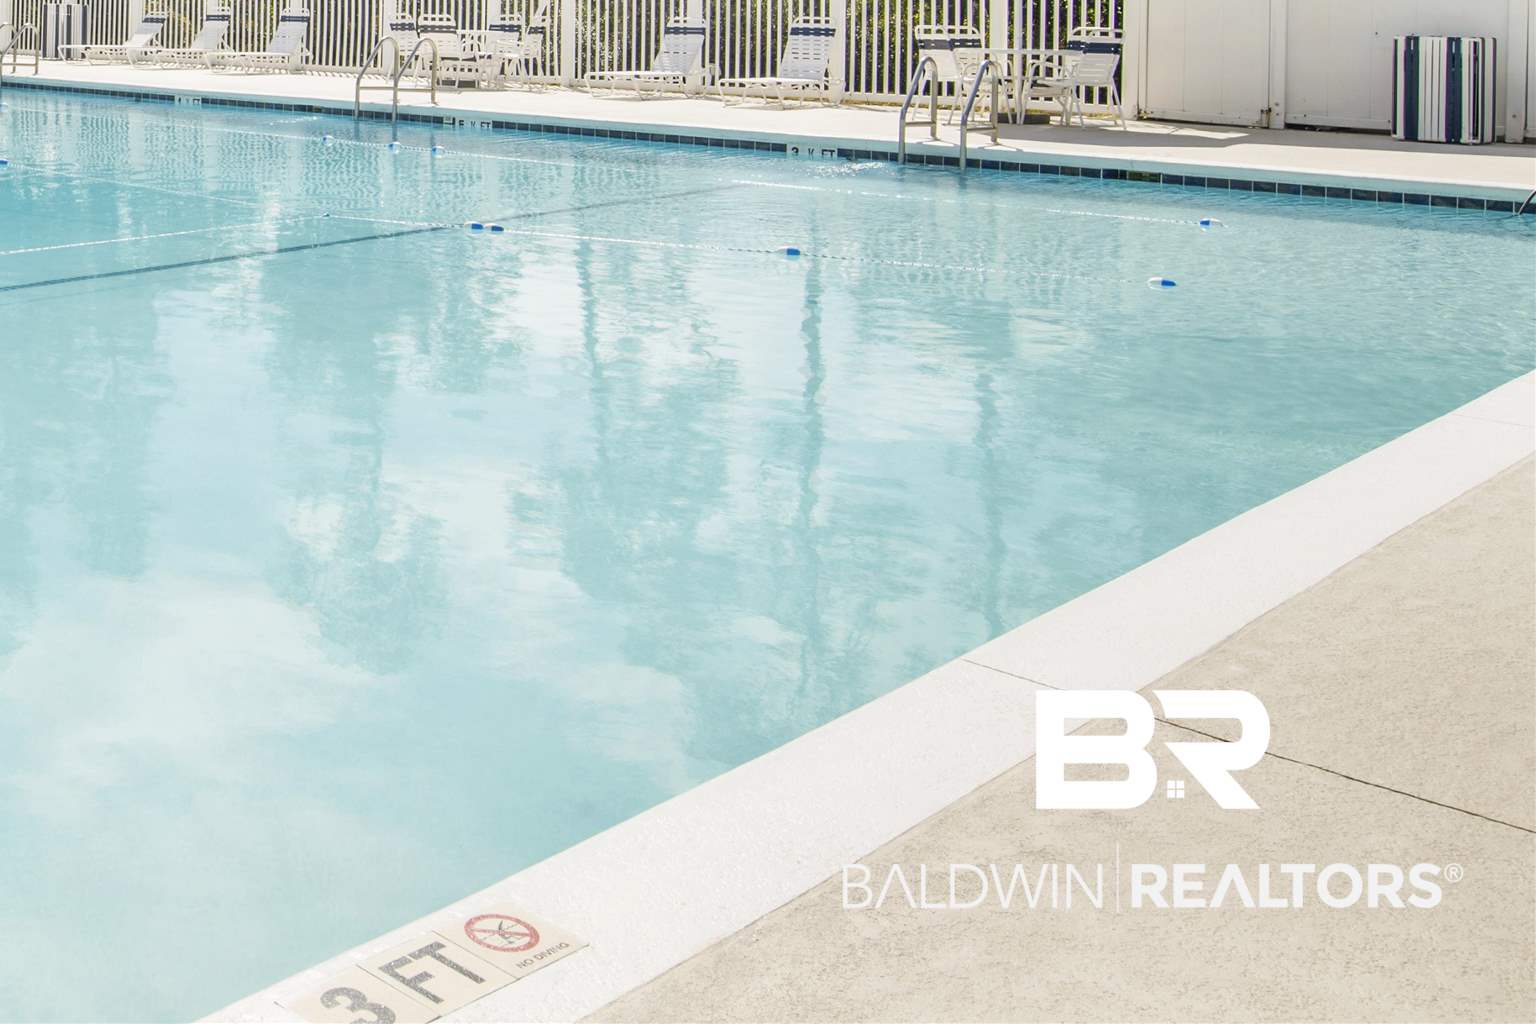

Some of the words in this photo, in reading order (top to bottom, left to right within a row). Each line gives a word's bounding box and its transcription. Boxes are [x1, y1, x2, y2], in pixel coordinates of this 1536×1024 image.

[319, 986, 396, 1024] 3
[378, 940, 486, 1005] FT
[515, 957, 535, 971] NO
[536, 941, 571, 961] DIVING
